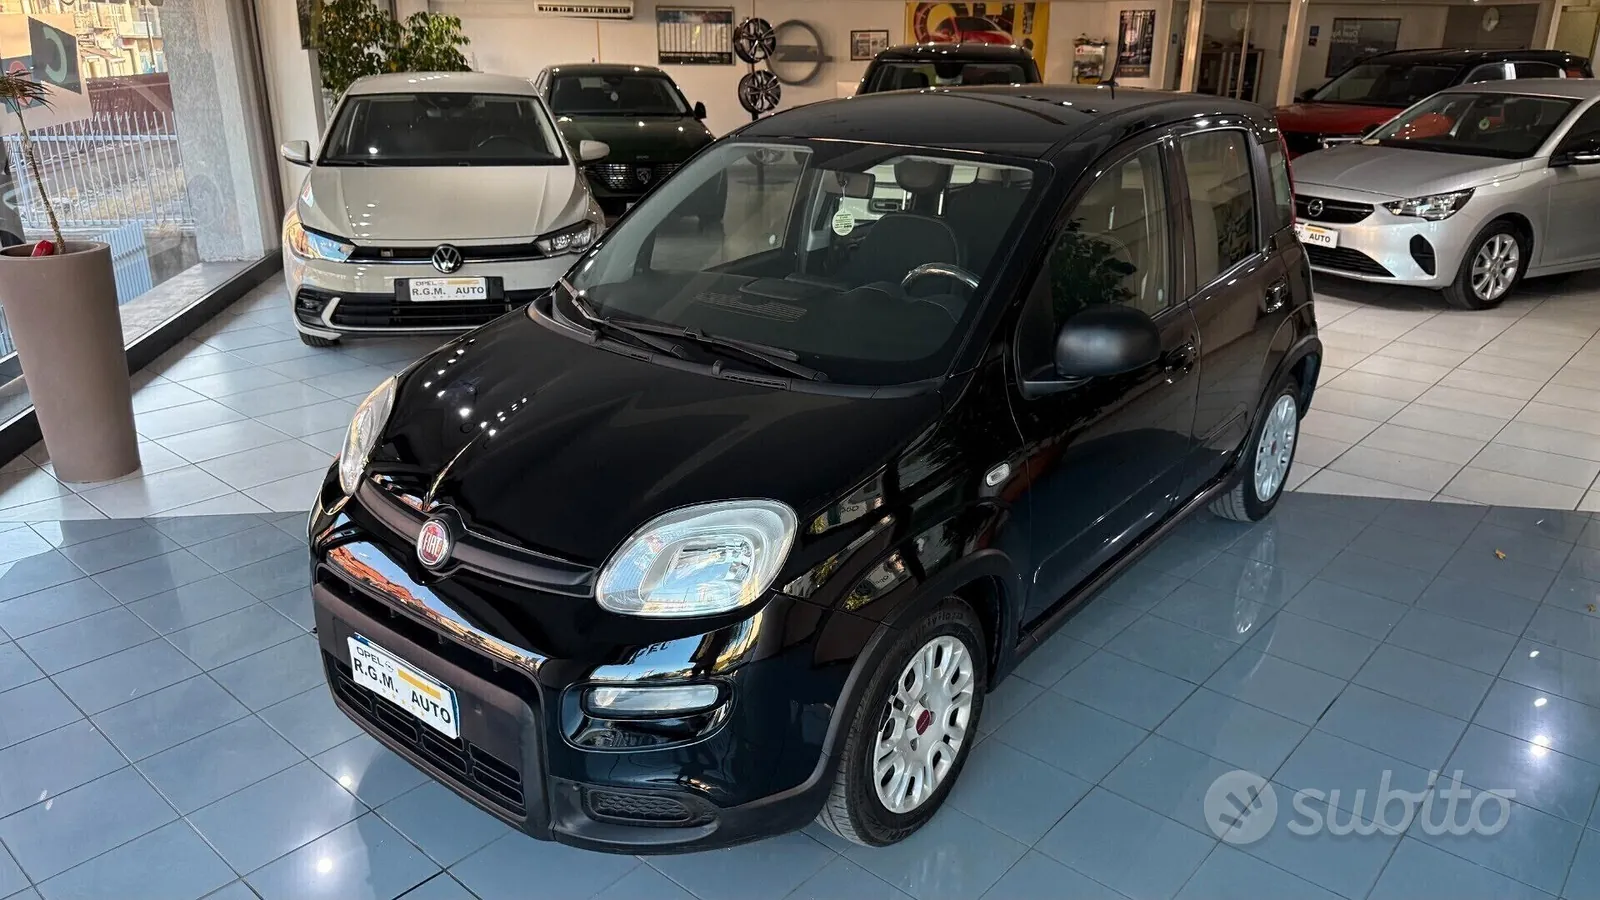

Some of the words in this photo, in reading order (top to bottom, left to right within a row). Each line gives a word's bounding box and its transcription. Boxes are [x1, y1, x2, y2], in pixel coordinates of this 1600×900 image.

[1309, 233, 1331, 243] AUTO
[412, 288, 446, 296] R.G.M.
[455, 287, 485, 295] AUTO
[422, 531, 443, 558] FIAT
[356, 646, 385, 668] OPEL
[353, 657, 399, 693] R.G.M.
[411, 690, 451, 724] AUTO
